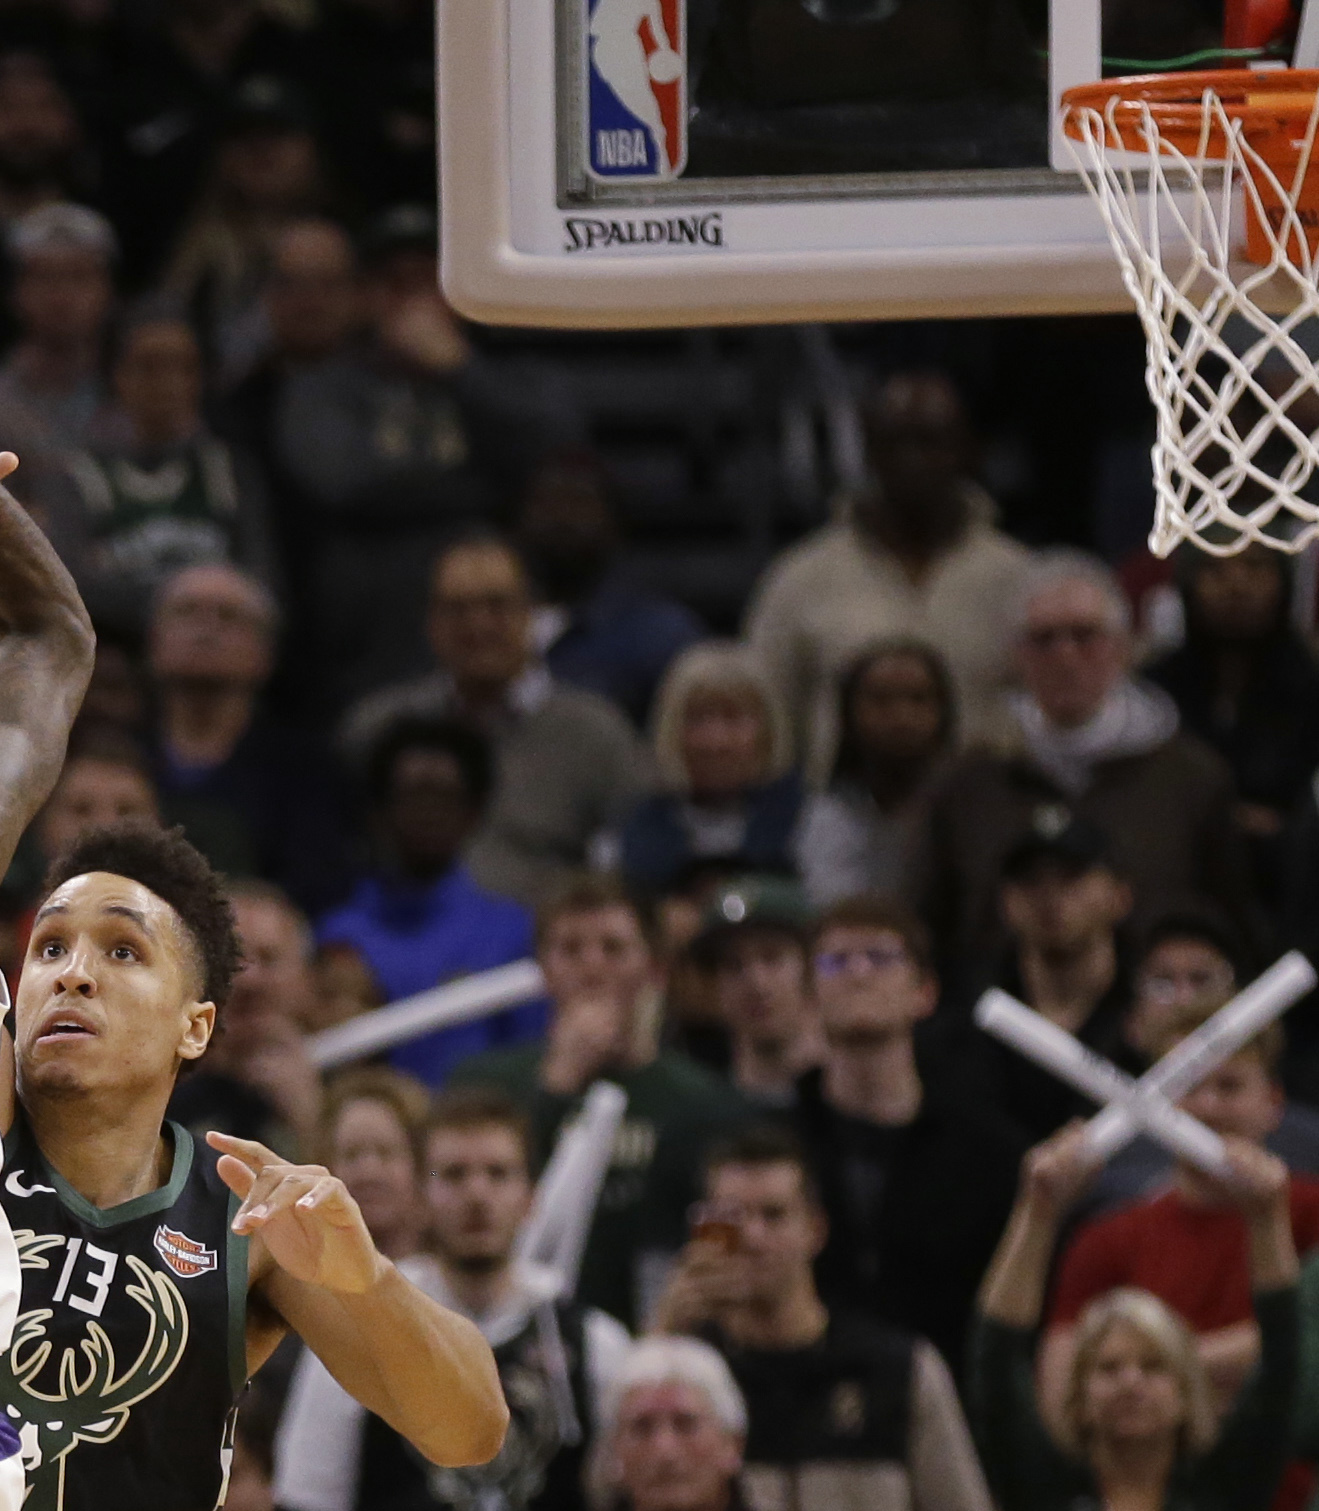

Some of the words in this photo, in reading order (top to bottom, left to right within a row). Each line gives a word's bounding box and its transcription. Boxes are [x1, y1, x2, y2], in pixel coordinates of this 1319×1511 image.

[596, 129, 648, 168] NBA
[564, 212, 723, 252] SPALDING
[52, 1237, 119, 1317] 13
